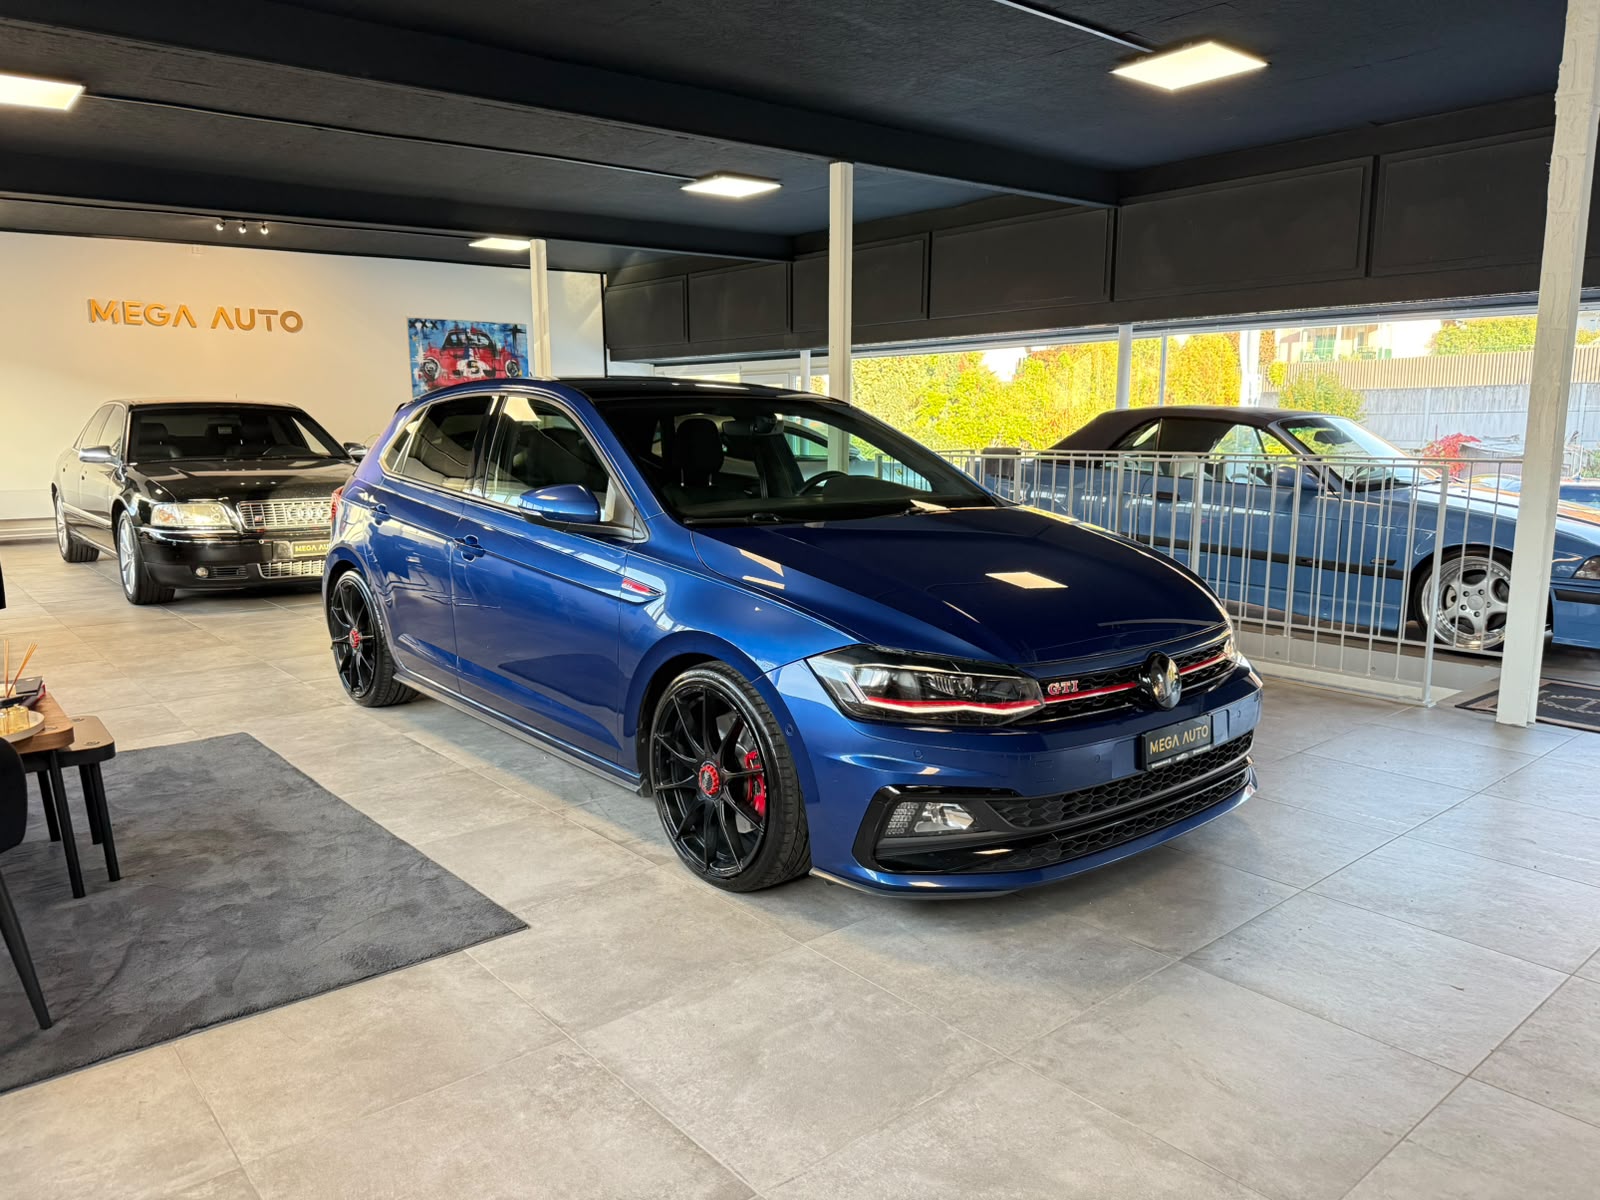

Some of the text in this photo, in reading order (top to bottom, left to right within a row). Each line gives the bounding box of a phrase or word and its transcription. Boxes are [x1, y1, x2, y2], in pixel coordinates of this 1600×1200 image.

[88, 298, 304, 333] MEGA AUTO
[1047, 680, 1079, 695] GTI
[1150, 734, 1180, 755] MEGA
[1182, 725, 1209, 745] AUTO
